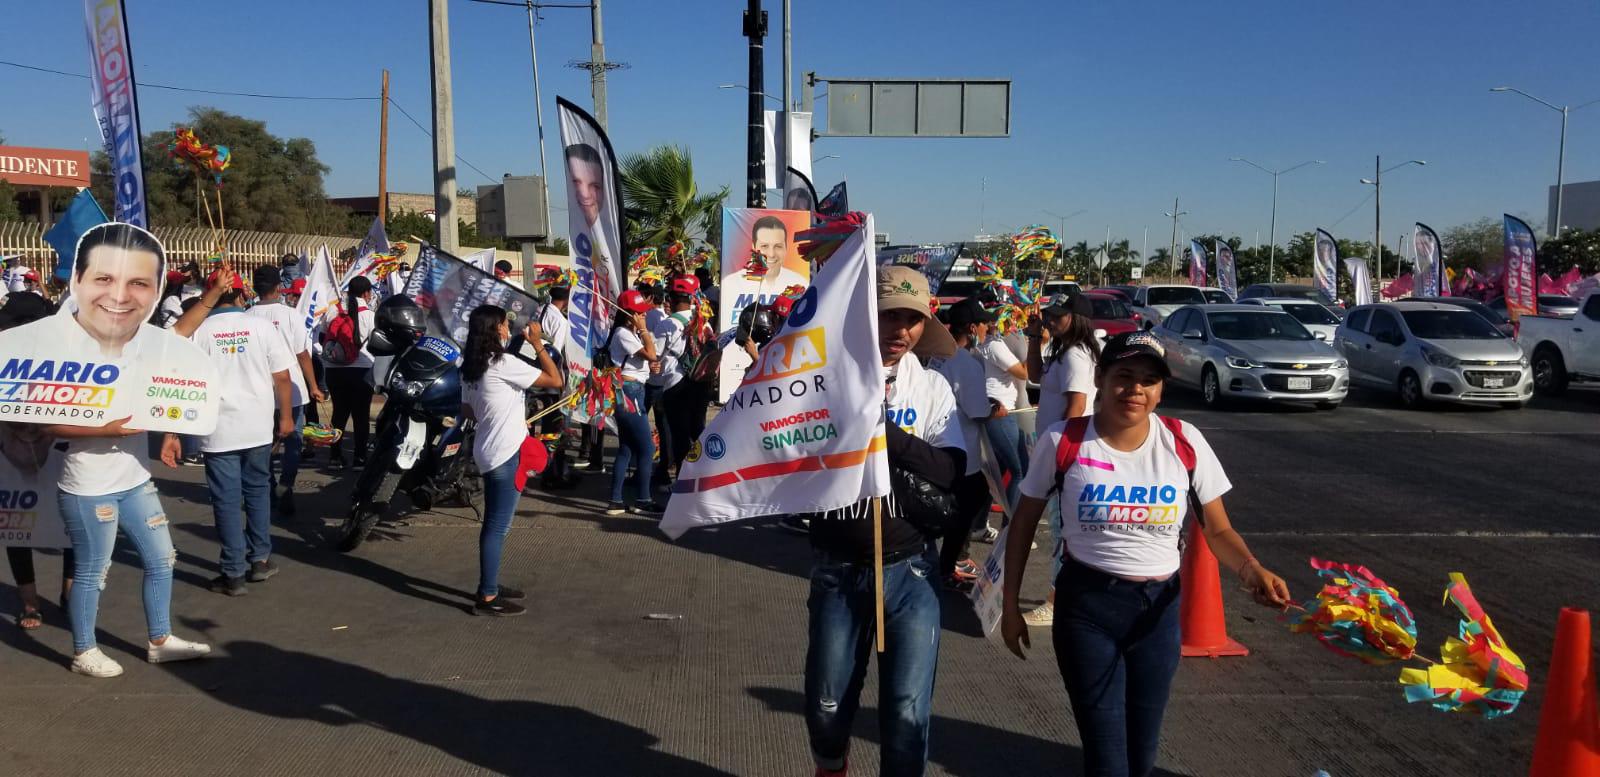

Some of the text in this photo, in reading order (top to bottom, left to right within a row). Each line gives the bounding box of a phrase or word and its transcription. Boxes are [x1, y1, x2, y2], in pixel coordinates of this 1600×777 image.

[0, 155, 79, 177] IDENTE
[1520, 247, 1534, 309] MUJERES
[569, 232, 594, 351] MARIO
[213, 331, 236, 339] VAMOS
[216, 337, 248, 347] SINALOA
[0, 358, 120, 385] MARIO
[151, 376, 207, 388] VAMOS POR
[0, 383, 112, 407] ZAMORA
[146, 385, 207, 402] SINALOA
[760, 408, 830, 432] VAMOS POR
[762, 423, 838, 450] SINALOA
[1078, 483, 1177, 504] MARIO
[1079, 505, 1177, 522] ZAMORA
[1080, 523, 1174, 533] GOBERNADOR
